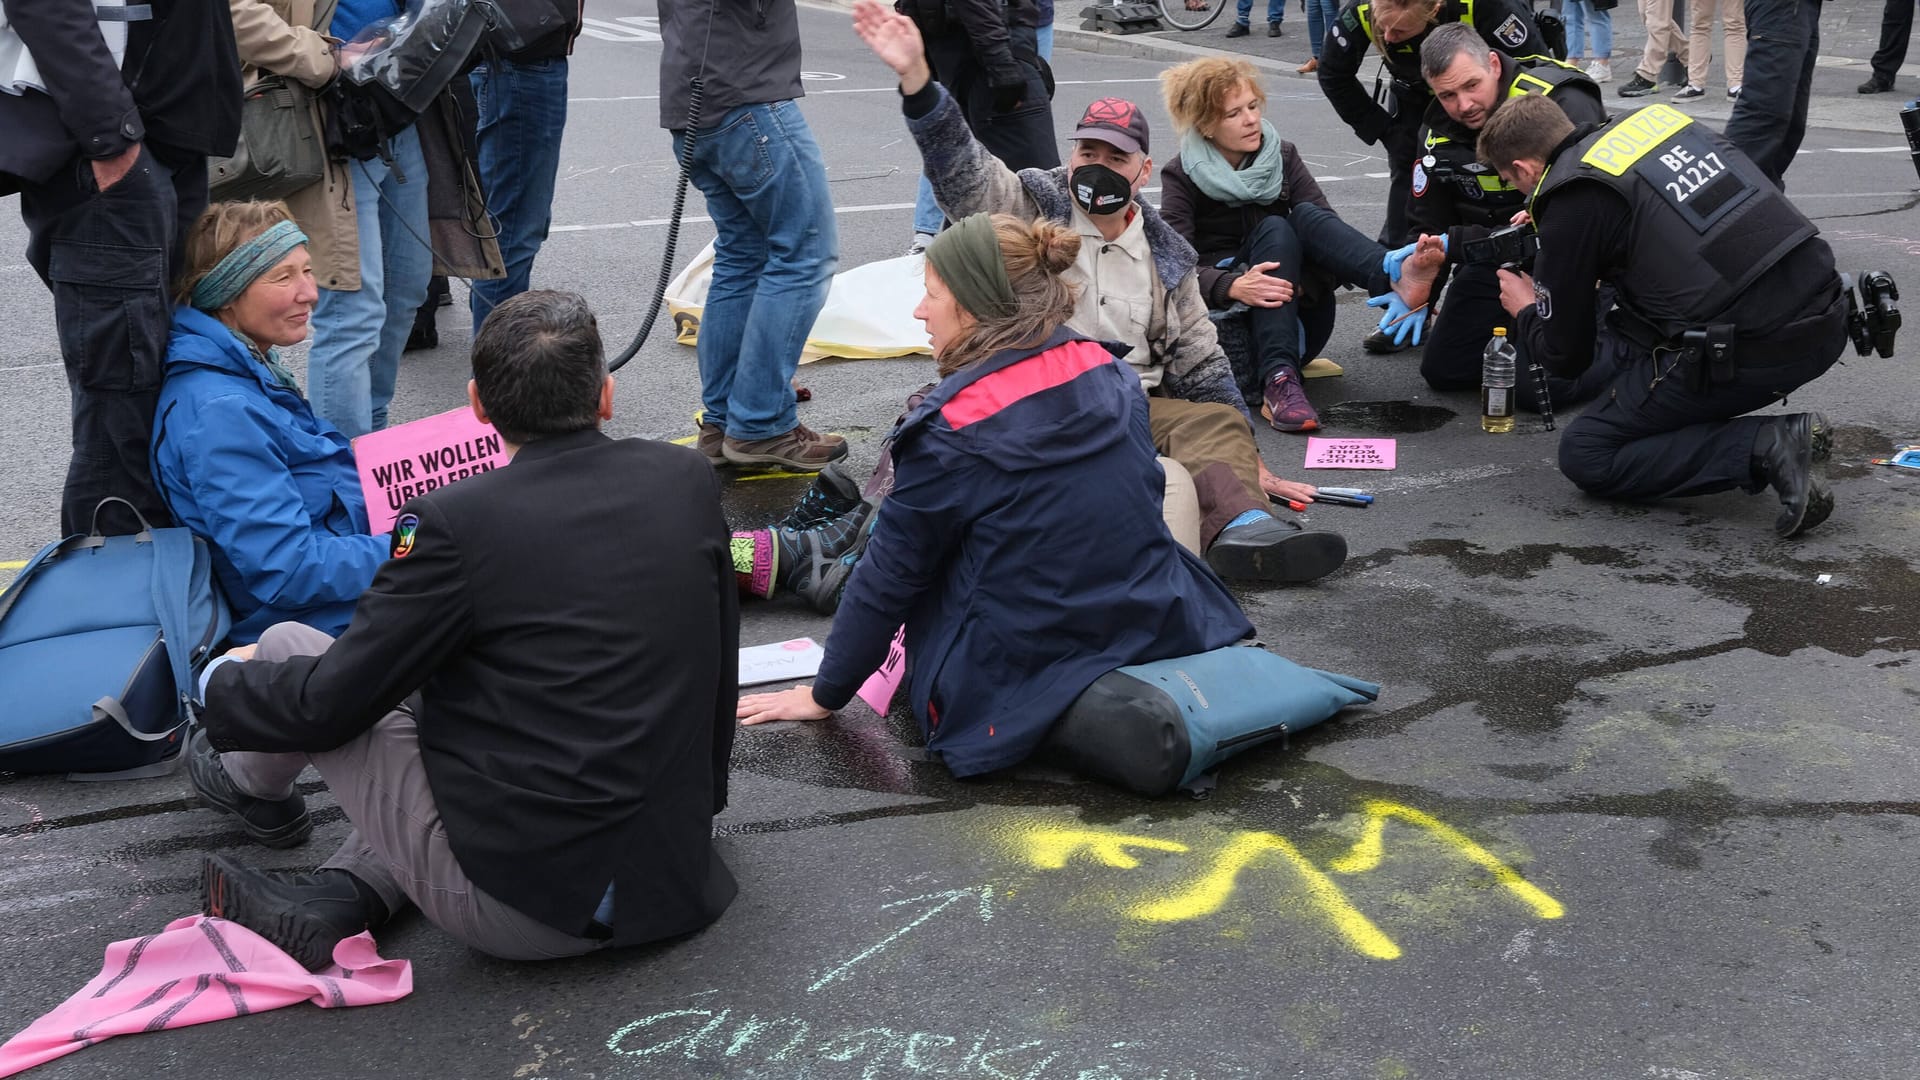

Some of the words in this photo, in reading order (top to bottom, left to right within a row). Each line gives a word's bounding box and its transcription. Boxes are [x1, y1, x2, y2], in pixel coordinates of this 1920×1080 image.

[1591, 105, 1684, 169] POLIZEI
[1659, 145, 1695, 172] BE
[1665, 152, 1726, 202] 21217
[372, 459, 416, 488] WIR
[419, 433, 500, 474] WOLLEN
